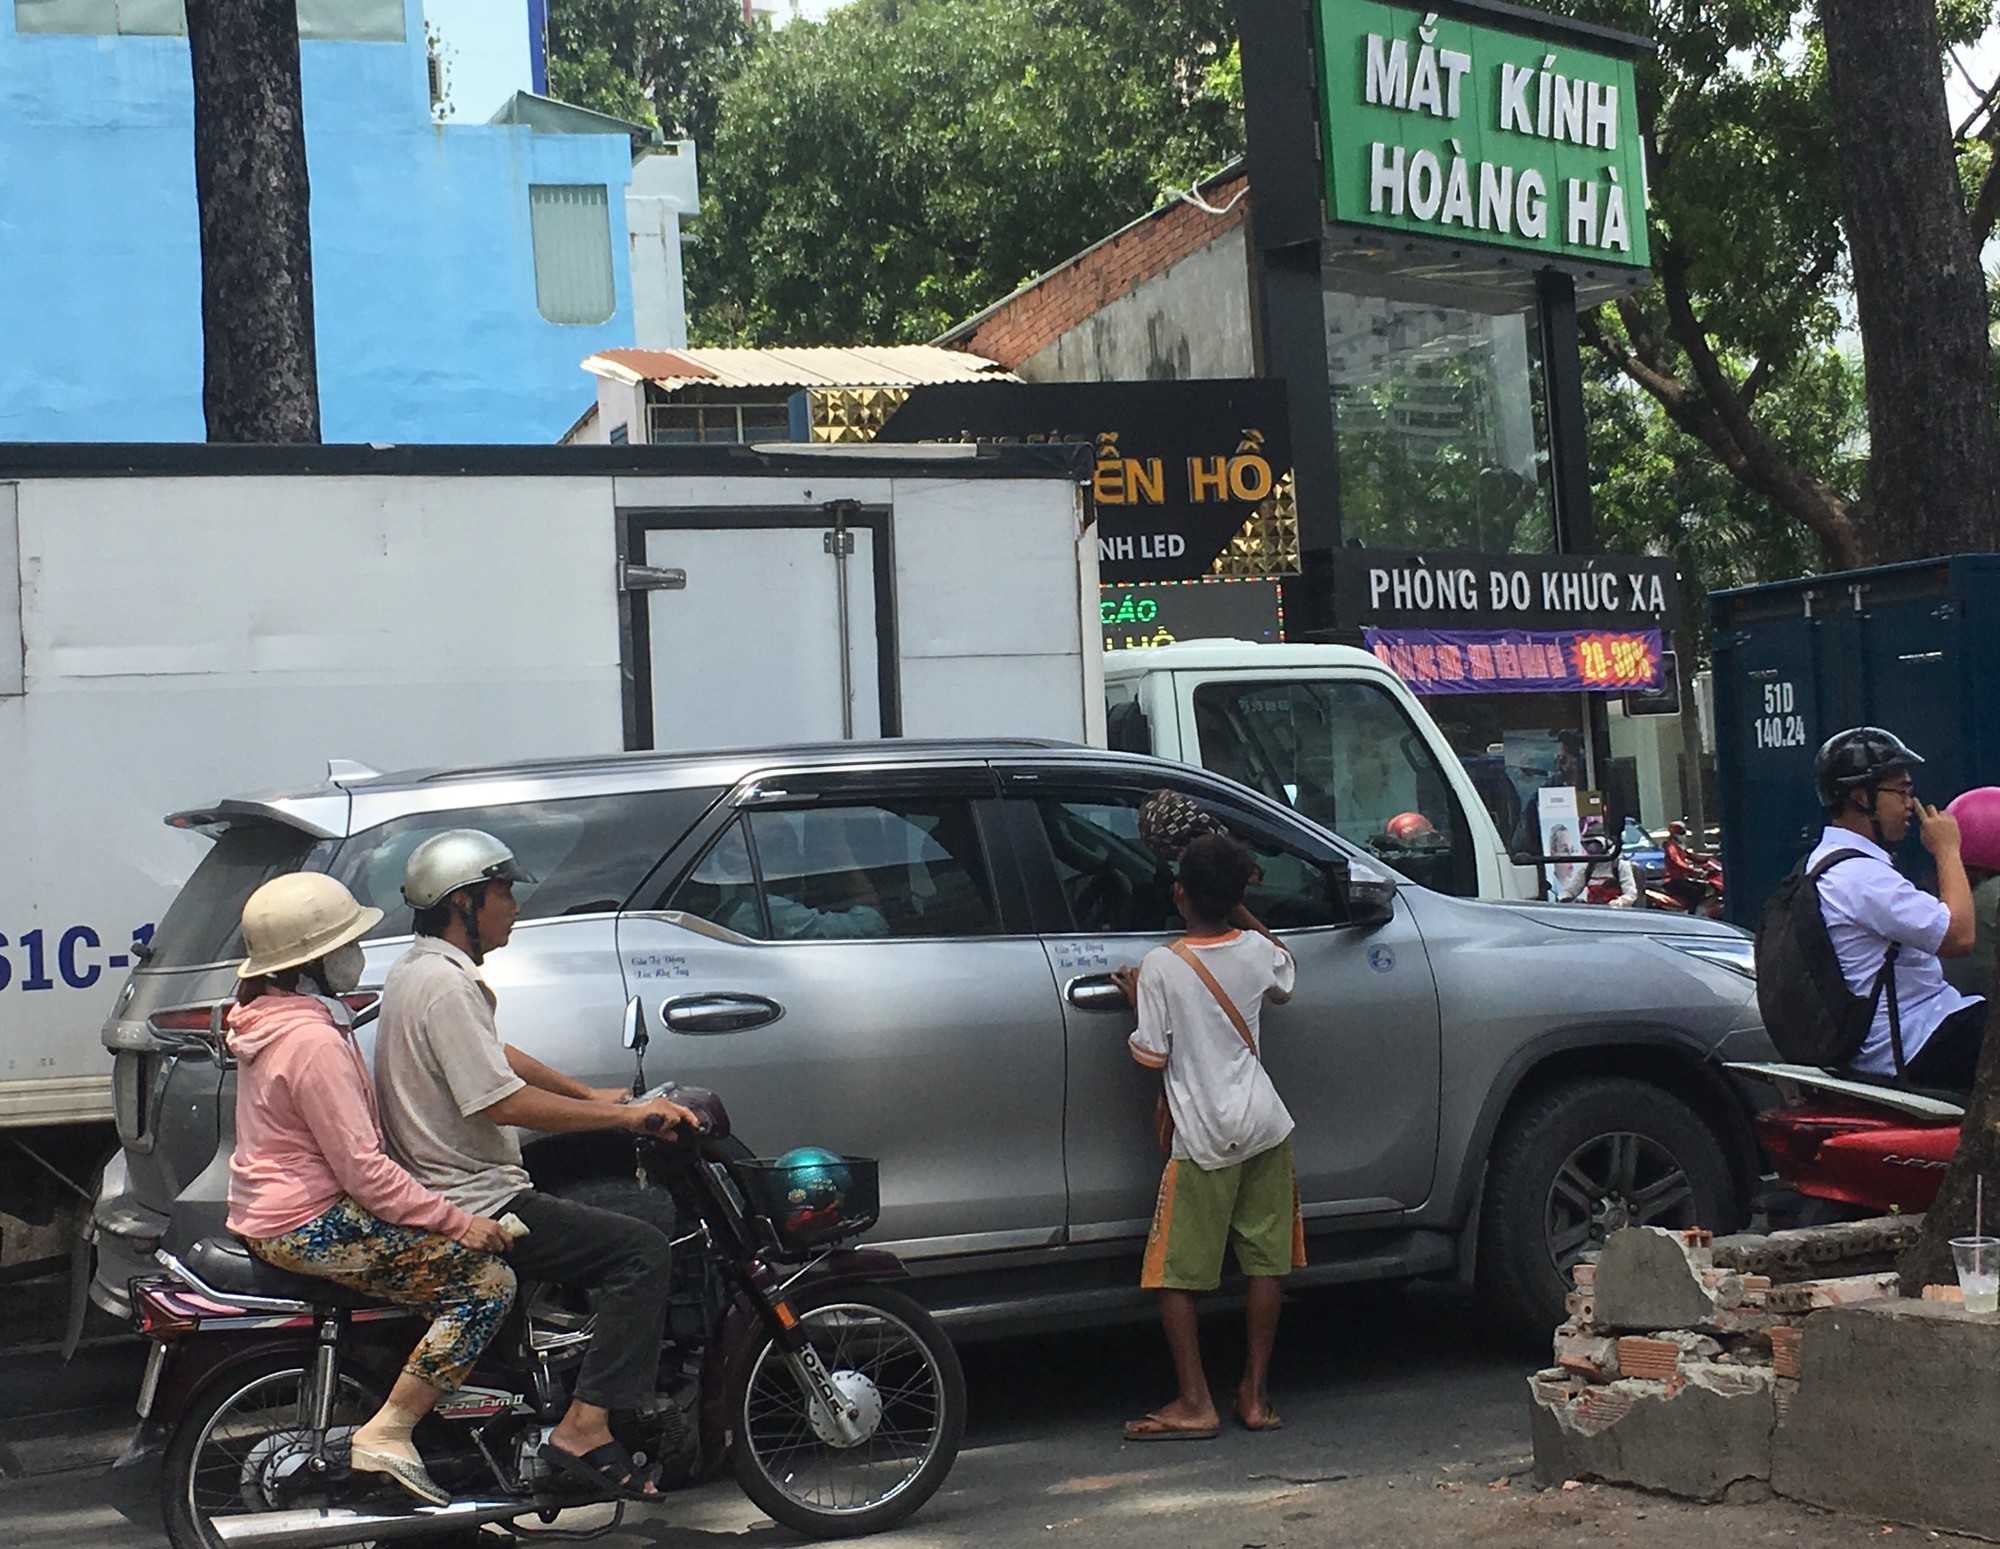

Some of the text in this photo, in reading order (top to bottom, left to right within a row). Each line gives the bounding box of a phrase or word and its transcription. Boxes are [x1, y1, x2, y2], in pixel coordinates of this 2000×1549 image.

[1366, 12, 1618, 150] MẮT KÍNH
[1370, 138, 1631, 251] HOÀNG HÀ
[1093, 431, 1164, 505] ỄN
[1098, 534, 1185, 561] NH LED
[1100, 594, 1157, 624] CÁO
[1369, 556, 1667, 620] PHÒNG ĐO KHÚC XẠ
[1764, 682, 1793, 714] 51D
[1754, 715, 1806, 749] 140.24
